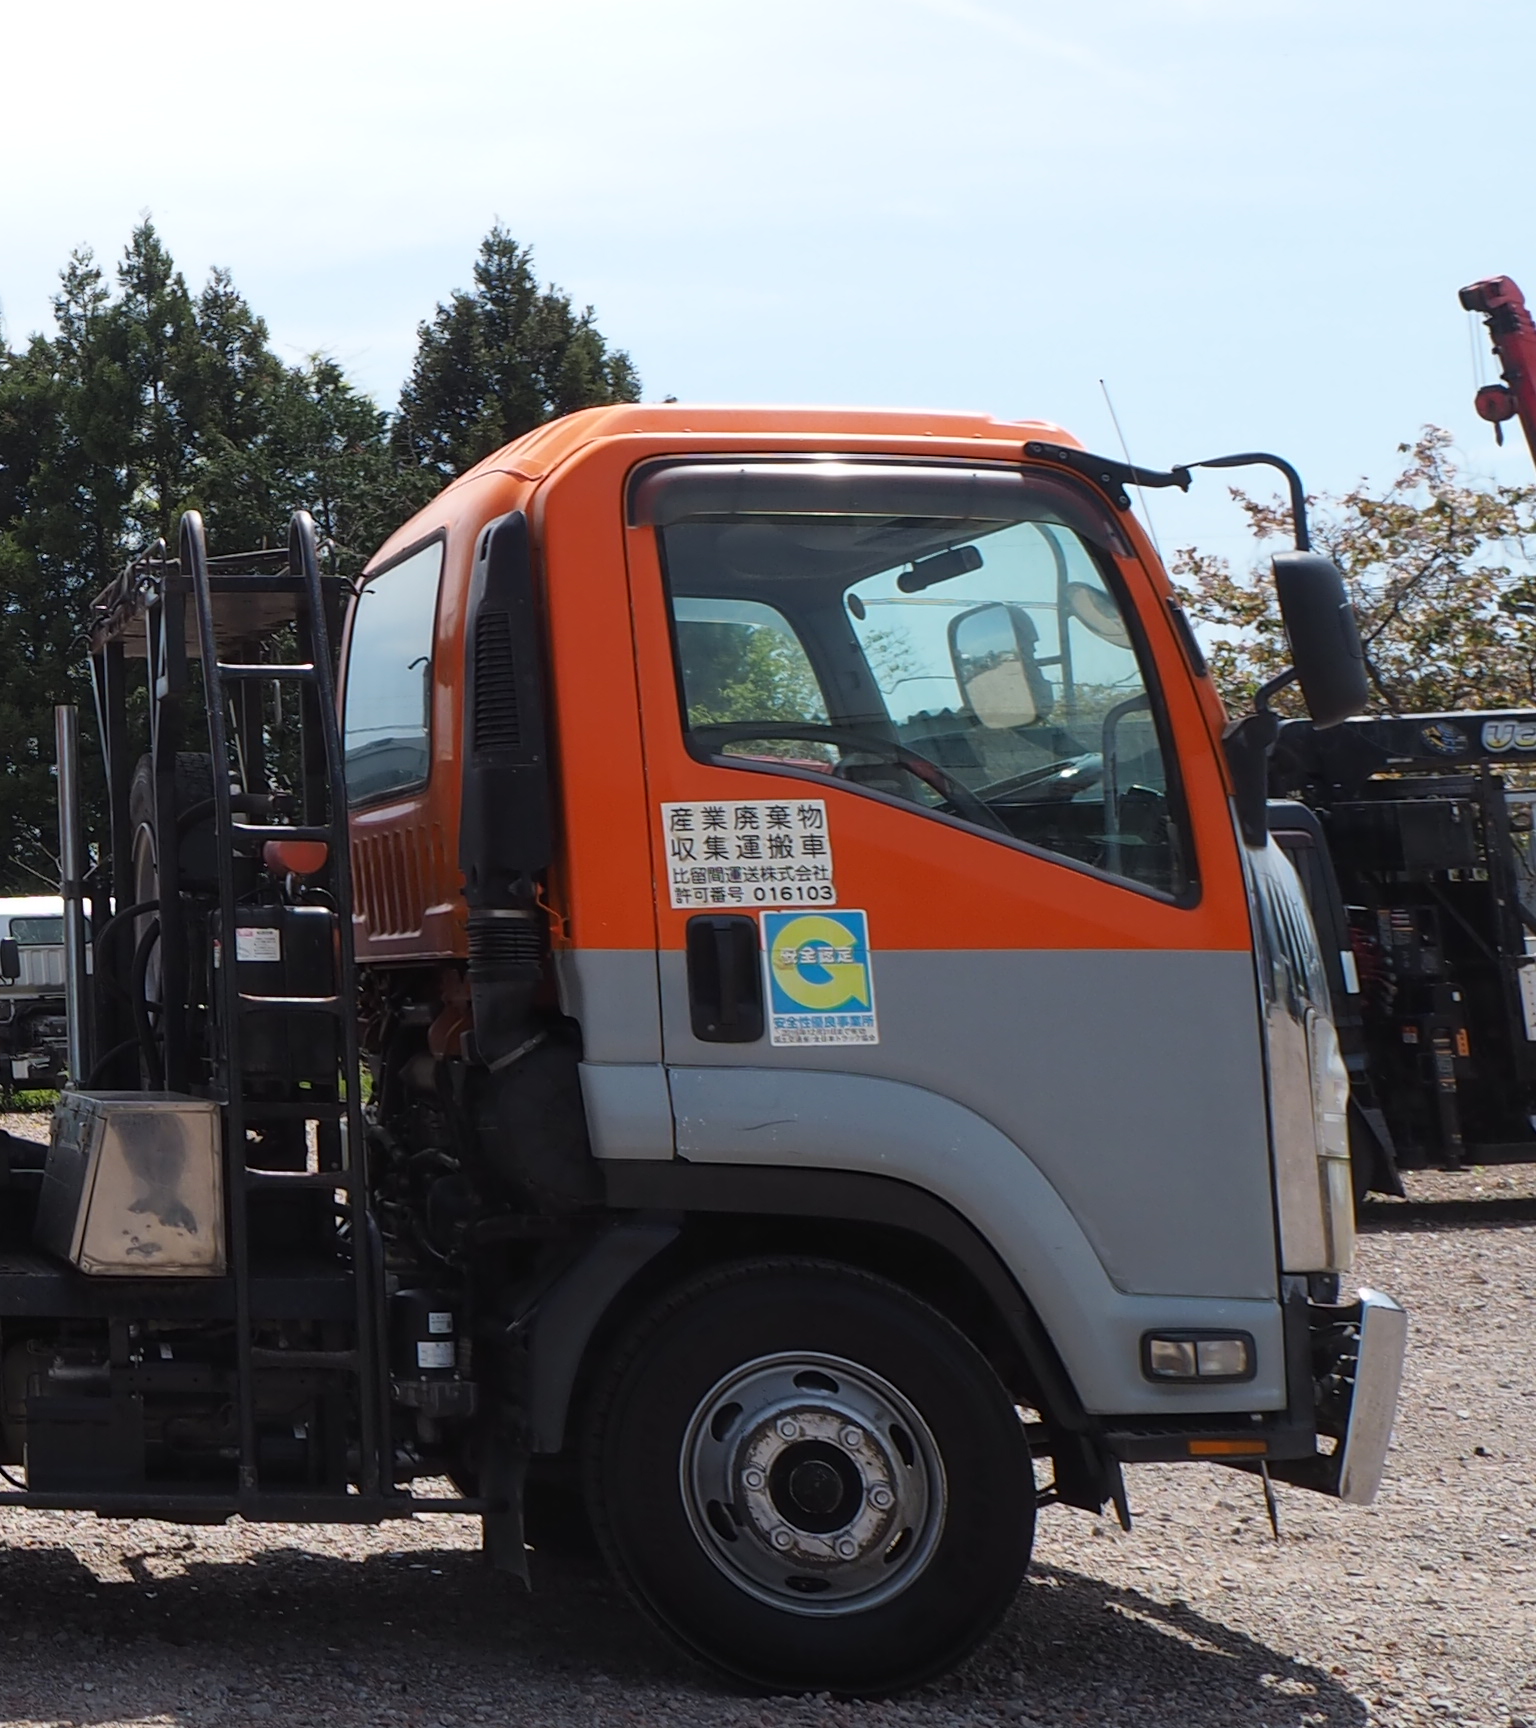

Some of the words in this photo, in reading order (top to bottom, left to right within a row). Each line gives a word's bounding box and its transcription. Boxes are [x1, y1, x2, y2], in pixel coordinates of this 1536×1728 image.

[669, 804, 823, 832] 産業廃棄物
[670, 833, 827, 861] 収集運搬車
[672, 865, 831, 885] 比留間運送株式会社
[674, 886, 744, 904] 許可番号
[753, 885, 833, 901] 016103
